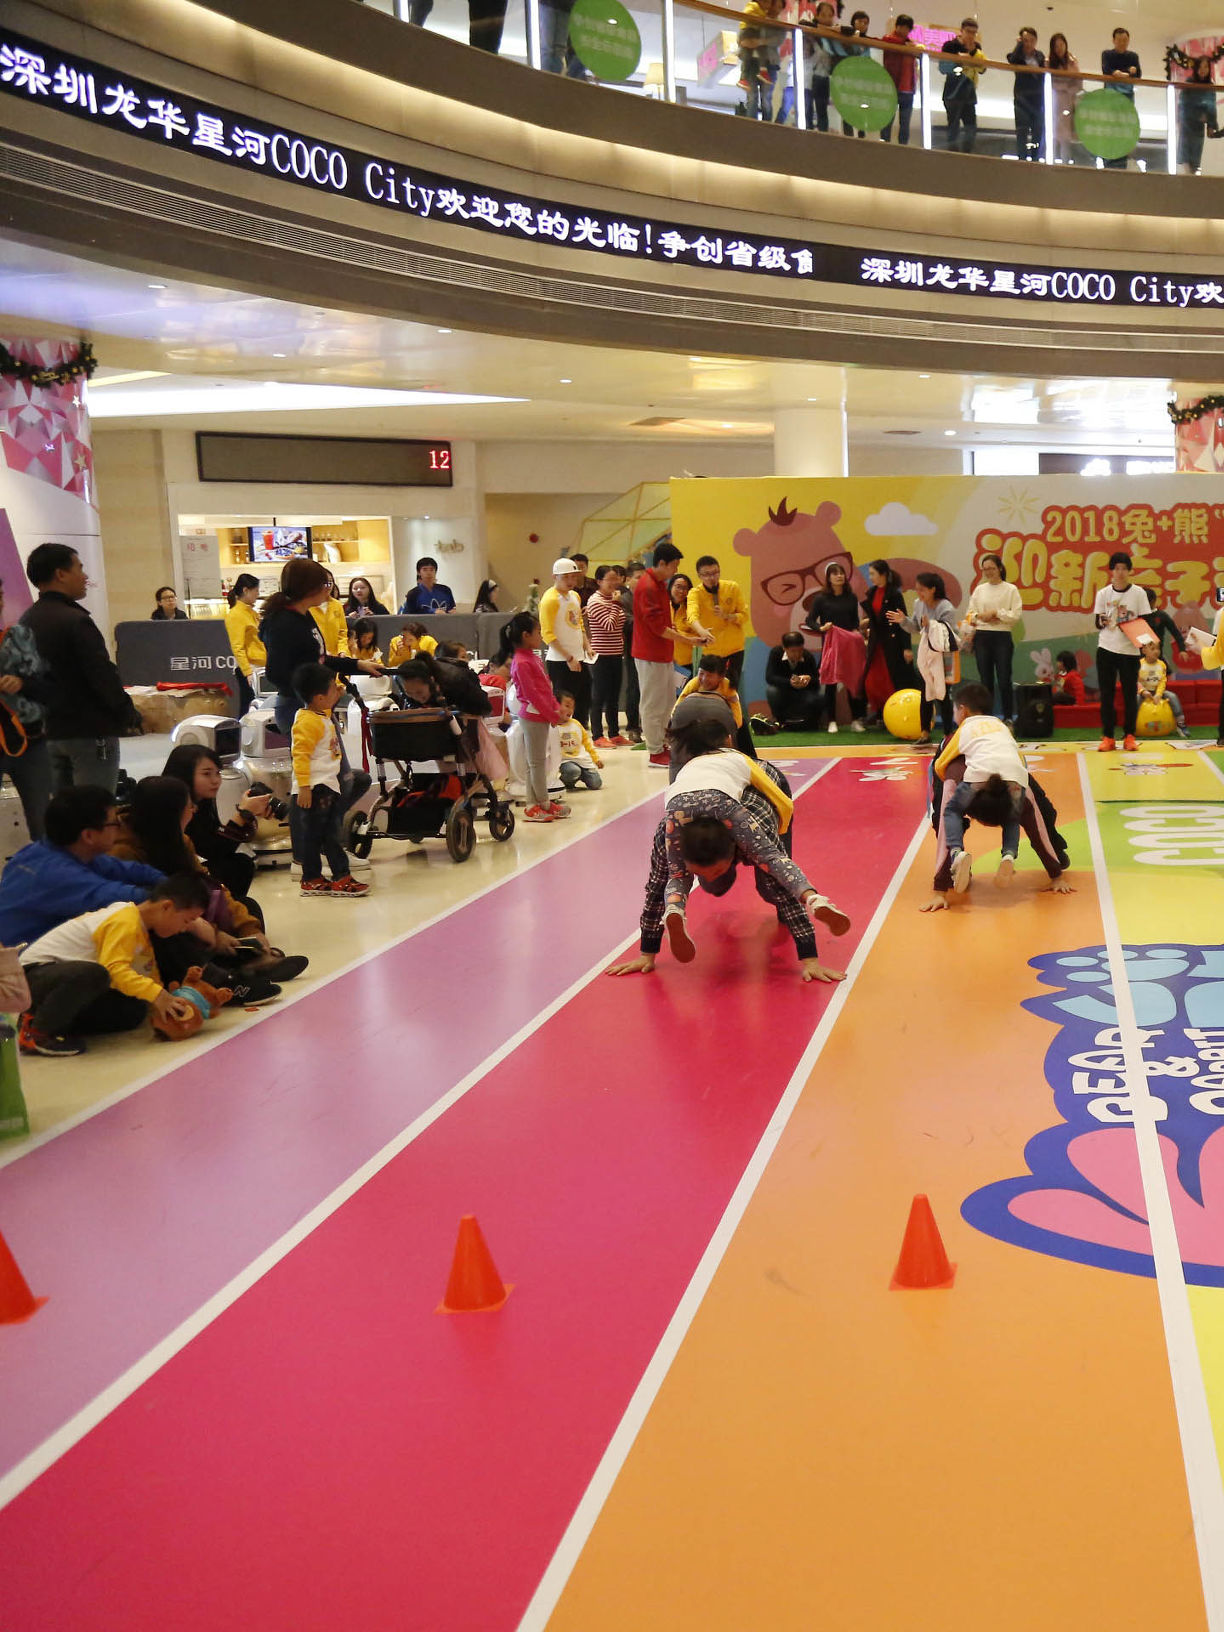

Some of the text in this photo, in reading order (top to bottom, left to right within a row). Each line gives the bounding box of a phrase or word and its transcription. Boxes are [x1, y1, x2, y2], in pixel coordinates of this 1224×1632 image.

[0, 45, 348, 189] 深圳龙华星河COCO
[861, 257, 1116, 302] 深圳龙华星河COCO
[429, 449, 451, 469] 12
[170, 655, 237, 671] 星河 CO
